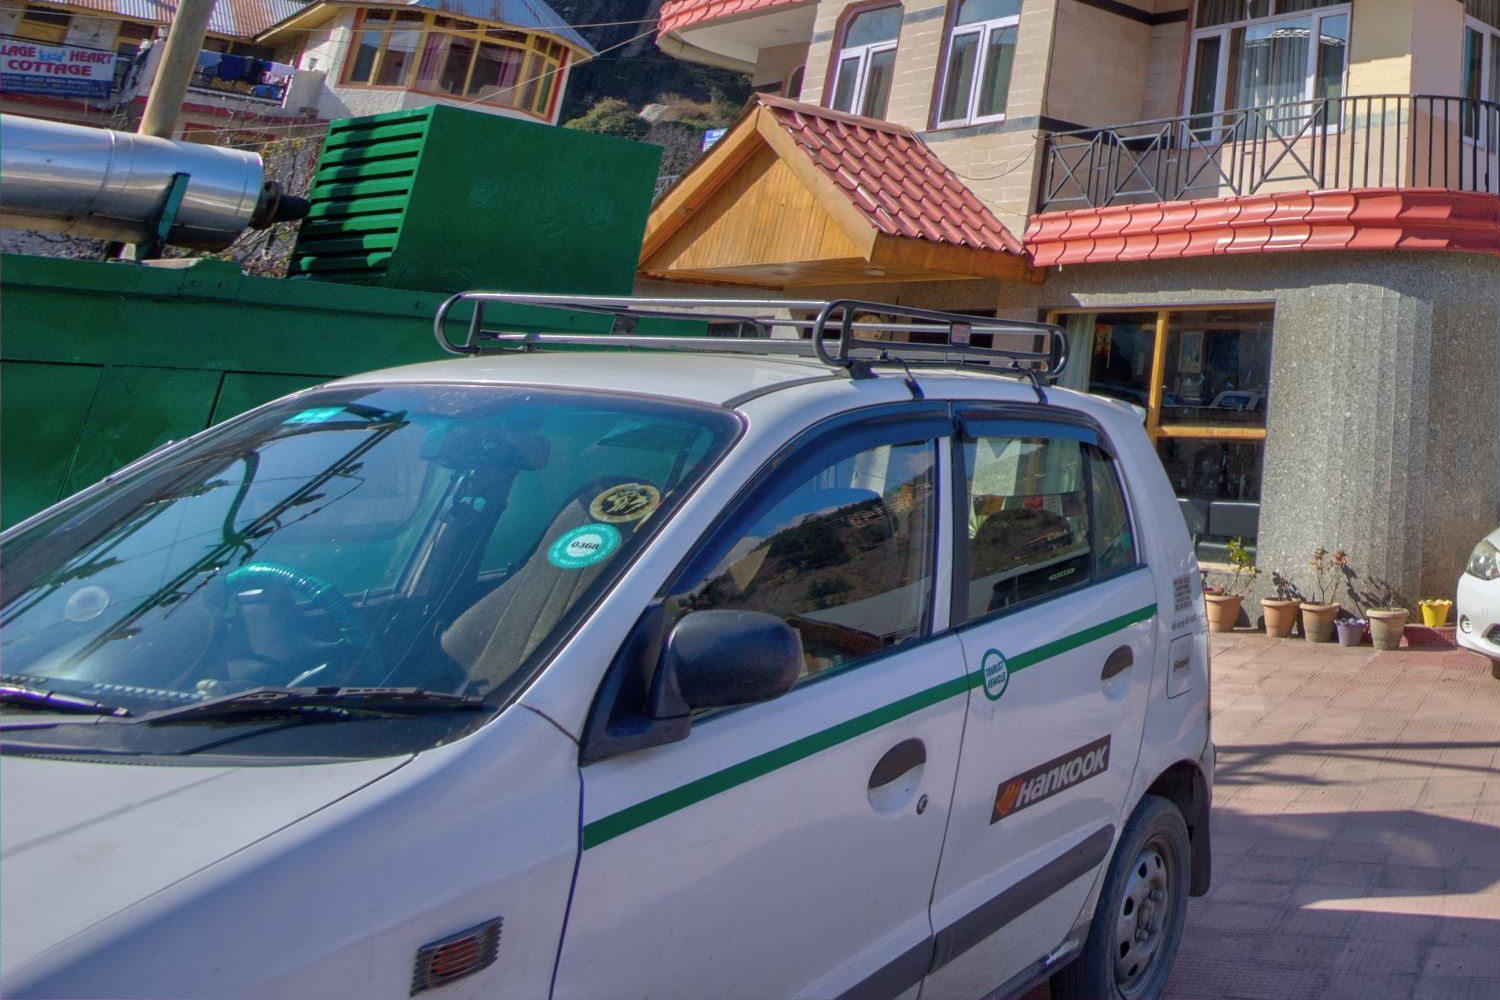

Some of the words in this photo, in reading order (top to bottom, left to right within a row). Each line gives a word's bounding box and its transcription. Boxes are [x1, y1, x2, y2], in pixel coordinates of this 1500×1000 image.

[69, 50, 113, 65] HEART
[7, 59, 93, 77] COTTAGE
[571, 541, 600, 550] 0368
[985, 660, 1004, 678] TOURIST
[987, 671, 1006, 689] VEHICLE
